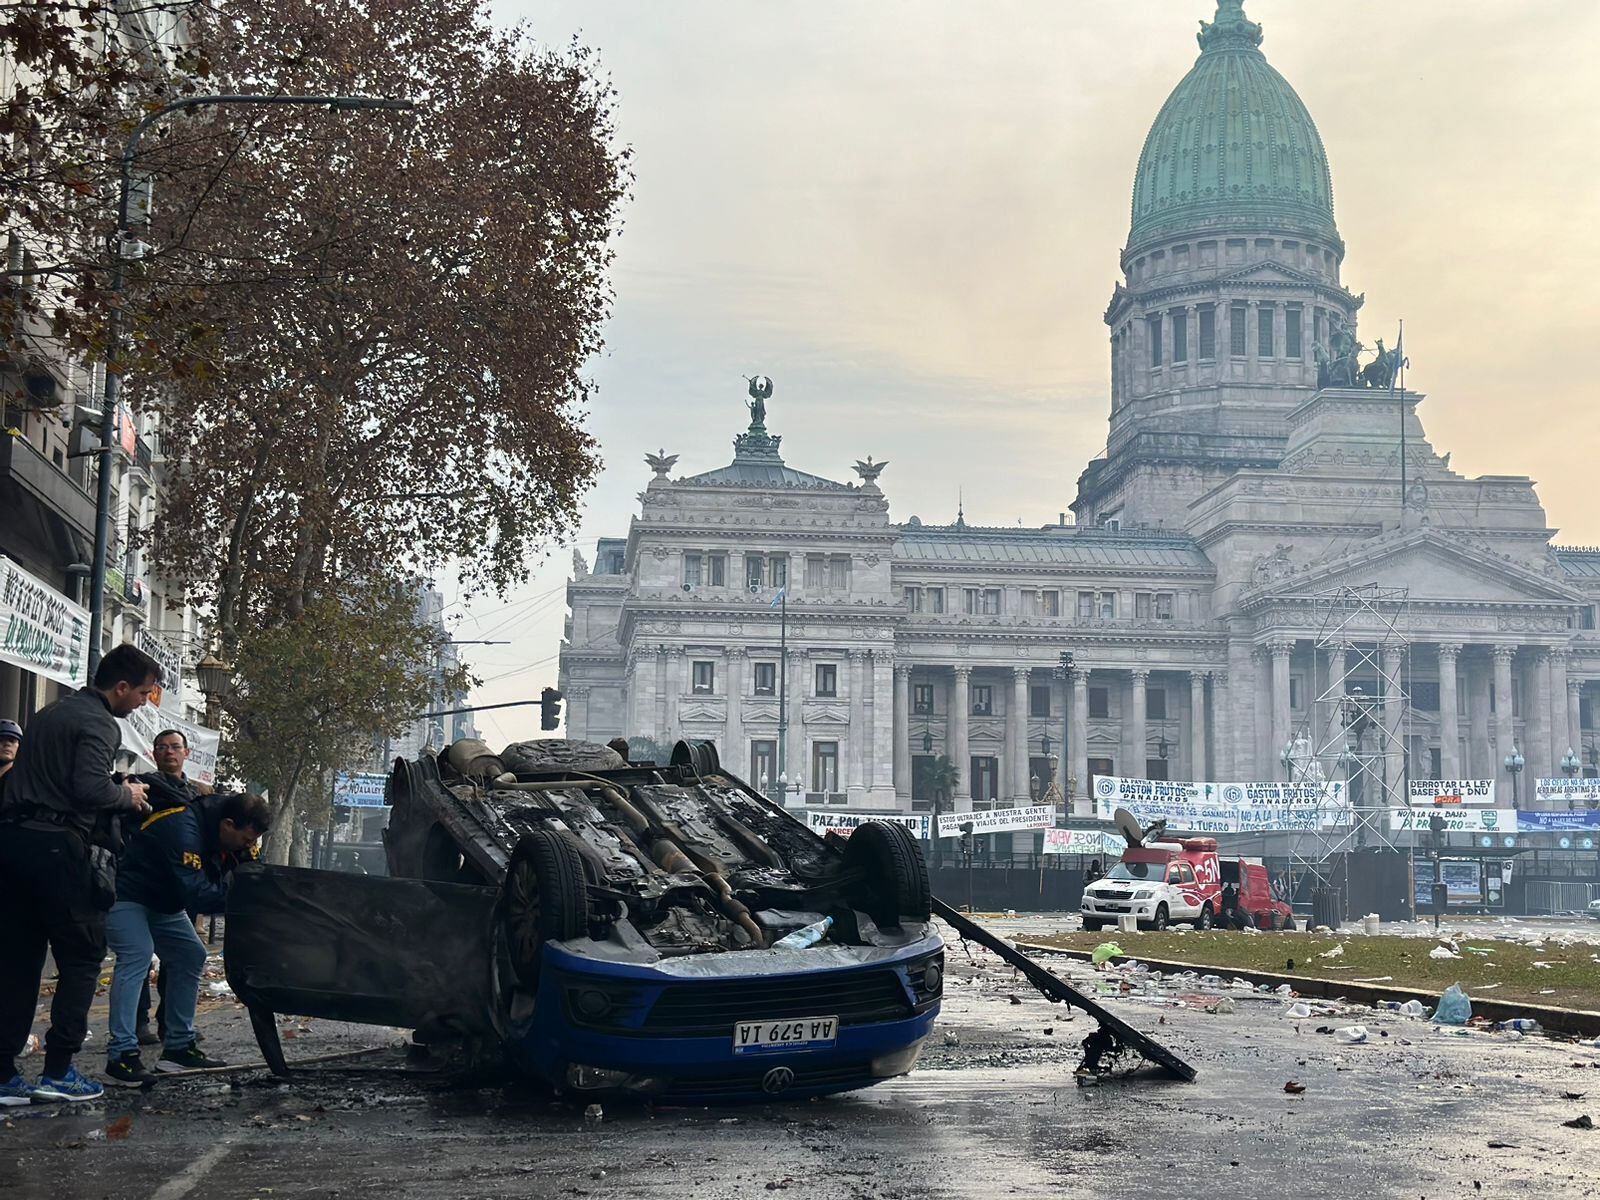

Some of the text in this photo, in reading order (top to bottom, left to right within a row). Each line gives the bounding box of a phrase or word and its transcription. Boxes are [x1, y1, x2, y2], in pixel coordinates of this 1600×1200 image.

[1410, 780, 1492, 788] DERROTAR LA LEY
[364, 786, 371, 794] LA
[1119, 783, 1152, 795] GASTON
[1155, 786, 1186, 797] FRUTOS
[1247, 789, 1280, 799] GASTON
[1283, 788, 1315, 798] FRUTOS
[1411, 788, 1488, 796] BASES Y EL DNU
[1123, 793, 1188, 803] PANADEROS
[940, 815, 956, 823] ESTOS
[956, 812, 982, 822] ULTRAJES
[993, 809, 1022, 818] NUESTRA
[1240, 810, 1252, 821] NO
[1254, 810, 1260, 821] A
[1263, 810, 1272, 820] LA
[1397, 810, 1408, 818] NO
[1410, 810, 1416, 818] A
[1417, 810, 1426, 818] LA
[838, 816, 860, 828] PAN
[975, 819, 997, 827] VIAJES
[998, 817, 1009, 825] DEL
[741, 1021, 833, 1044] AA 579 IA
